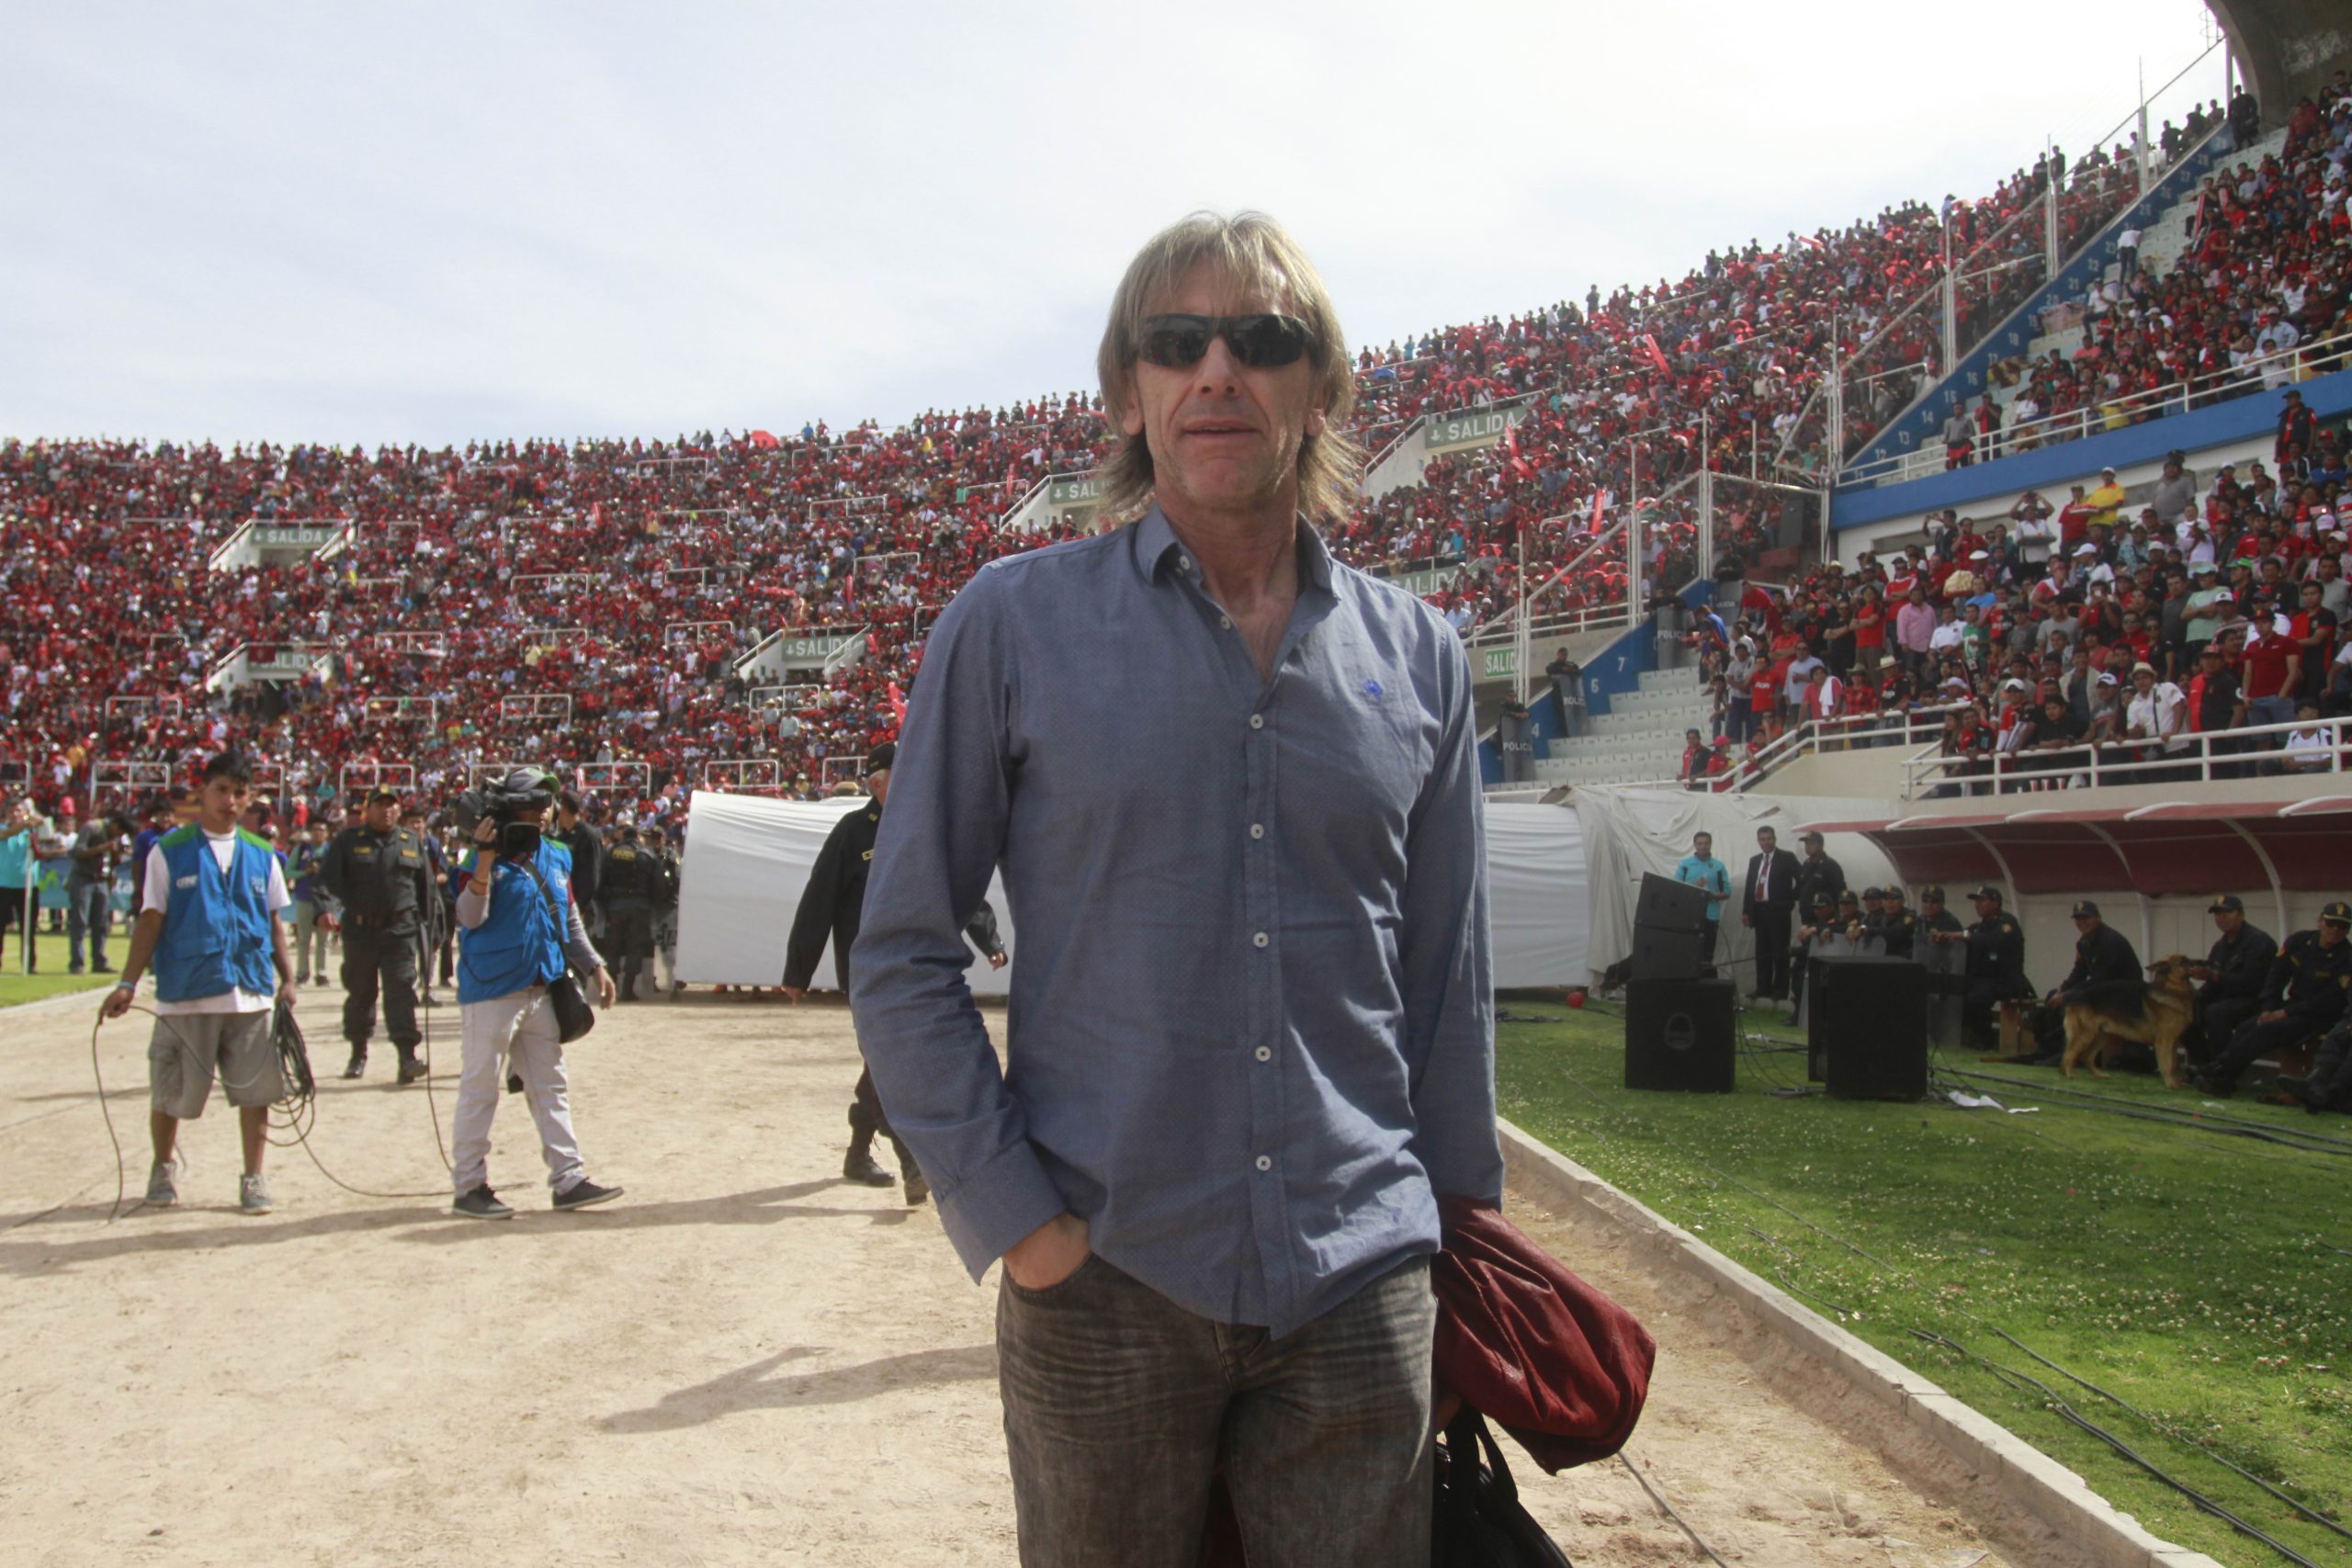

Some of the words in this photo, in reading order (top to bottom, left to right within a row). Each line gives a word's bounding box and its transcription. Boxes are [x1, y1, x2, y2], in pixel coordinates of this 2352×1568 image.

[1921, 410, 1934, 423] 14
[1448, 412, 1515, 441] SALIDA
[1898, 430, 1910, 445] 13
[1069, 482, 1100, 499] SAL
[267, 528, 322, 544] SALIDA
[1486, 650, 1516, 673] SALID
[1617, 657, 1625, 671] 7
[1590, 678, 1600, 693] 6
[1532, 722, 1540, 738] 4
